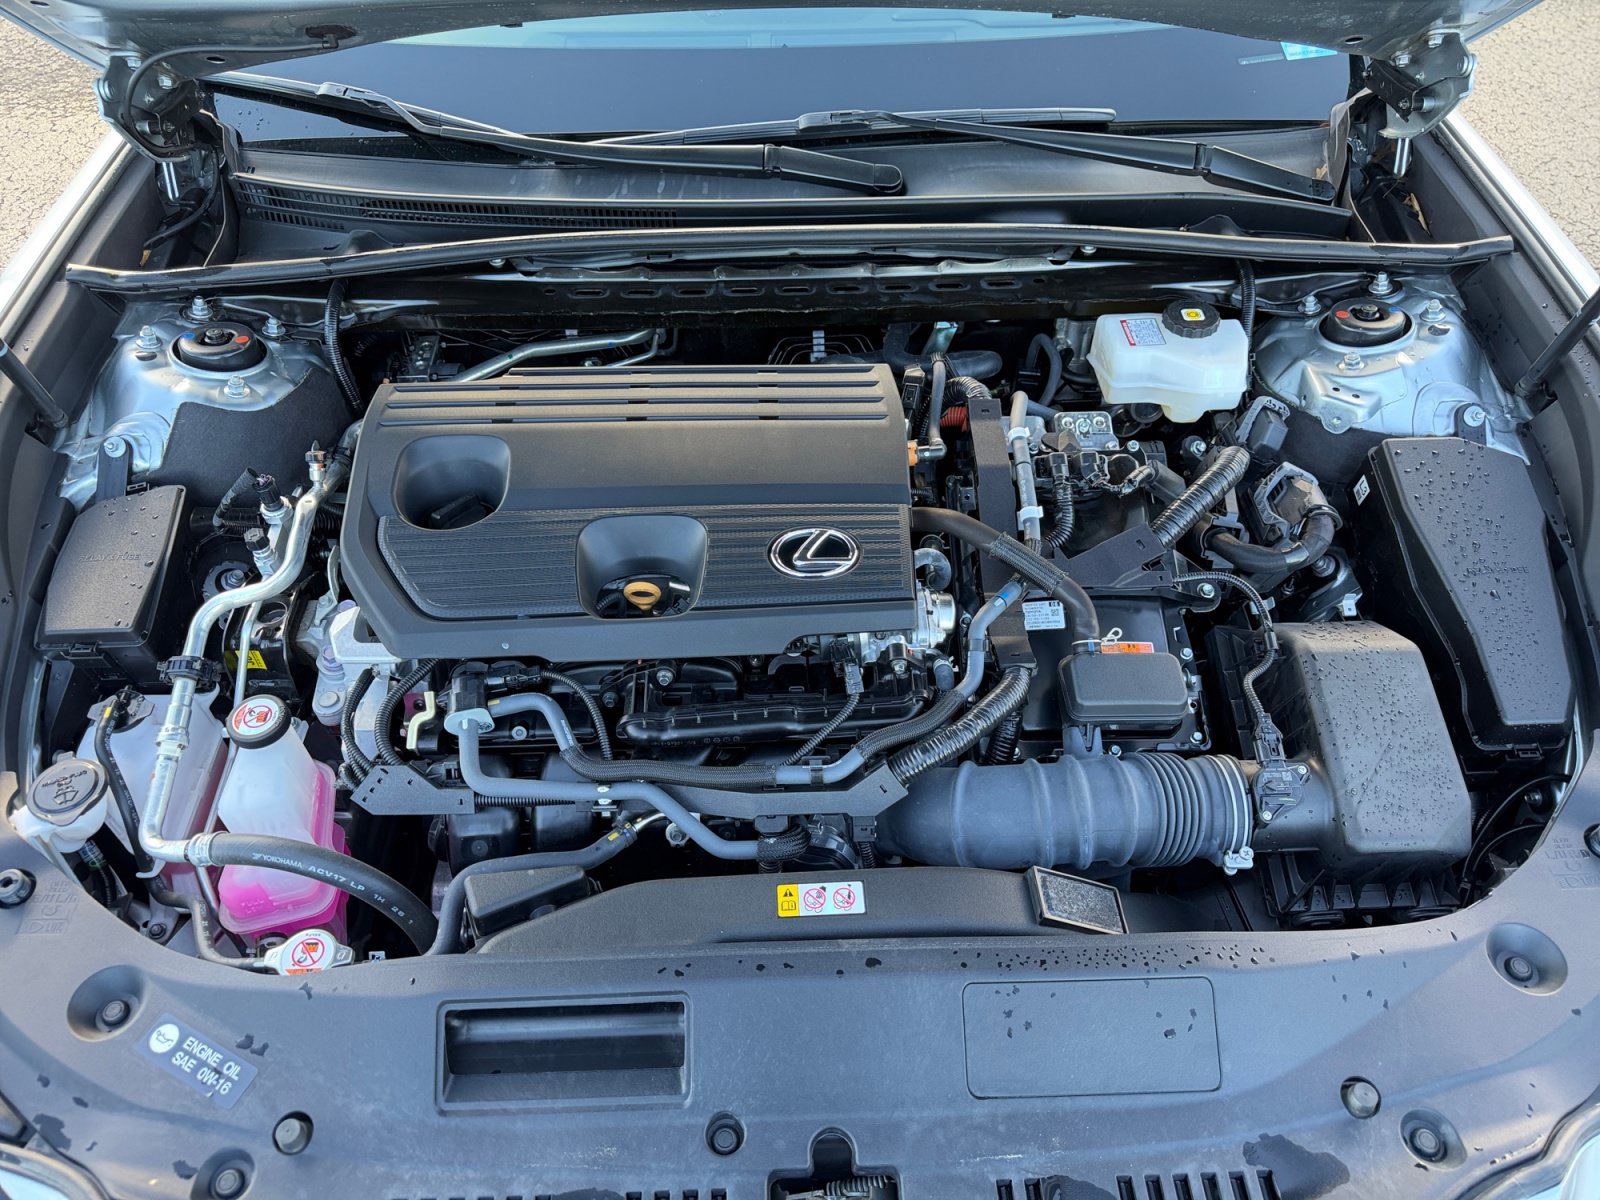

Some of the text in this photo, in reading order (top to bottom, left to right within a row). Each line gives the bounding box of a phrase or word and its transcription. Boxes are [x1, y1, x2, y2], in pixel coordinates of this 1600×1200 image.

[263, 854, 303, 869] YOKOHAMA
[308, 865, 347, 882] ACV17
[350, 881, 366, 891] LP
[373, 893, 386, 904] 1H
[171, 1051, 233, 1095] SAE 0W-16
[182, 1036, 241, 1081] ENGINE OIL
